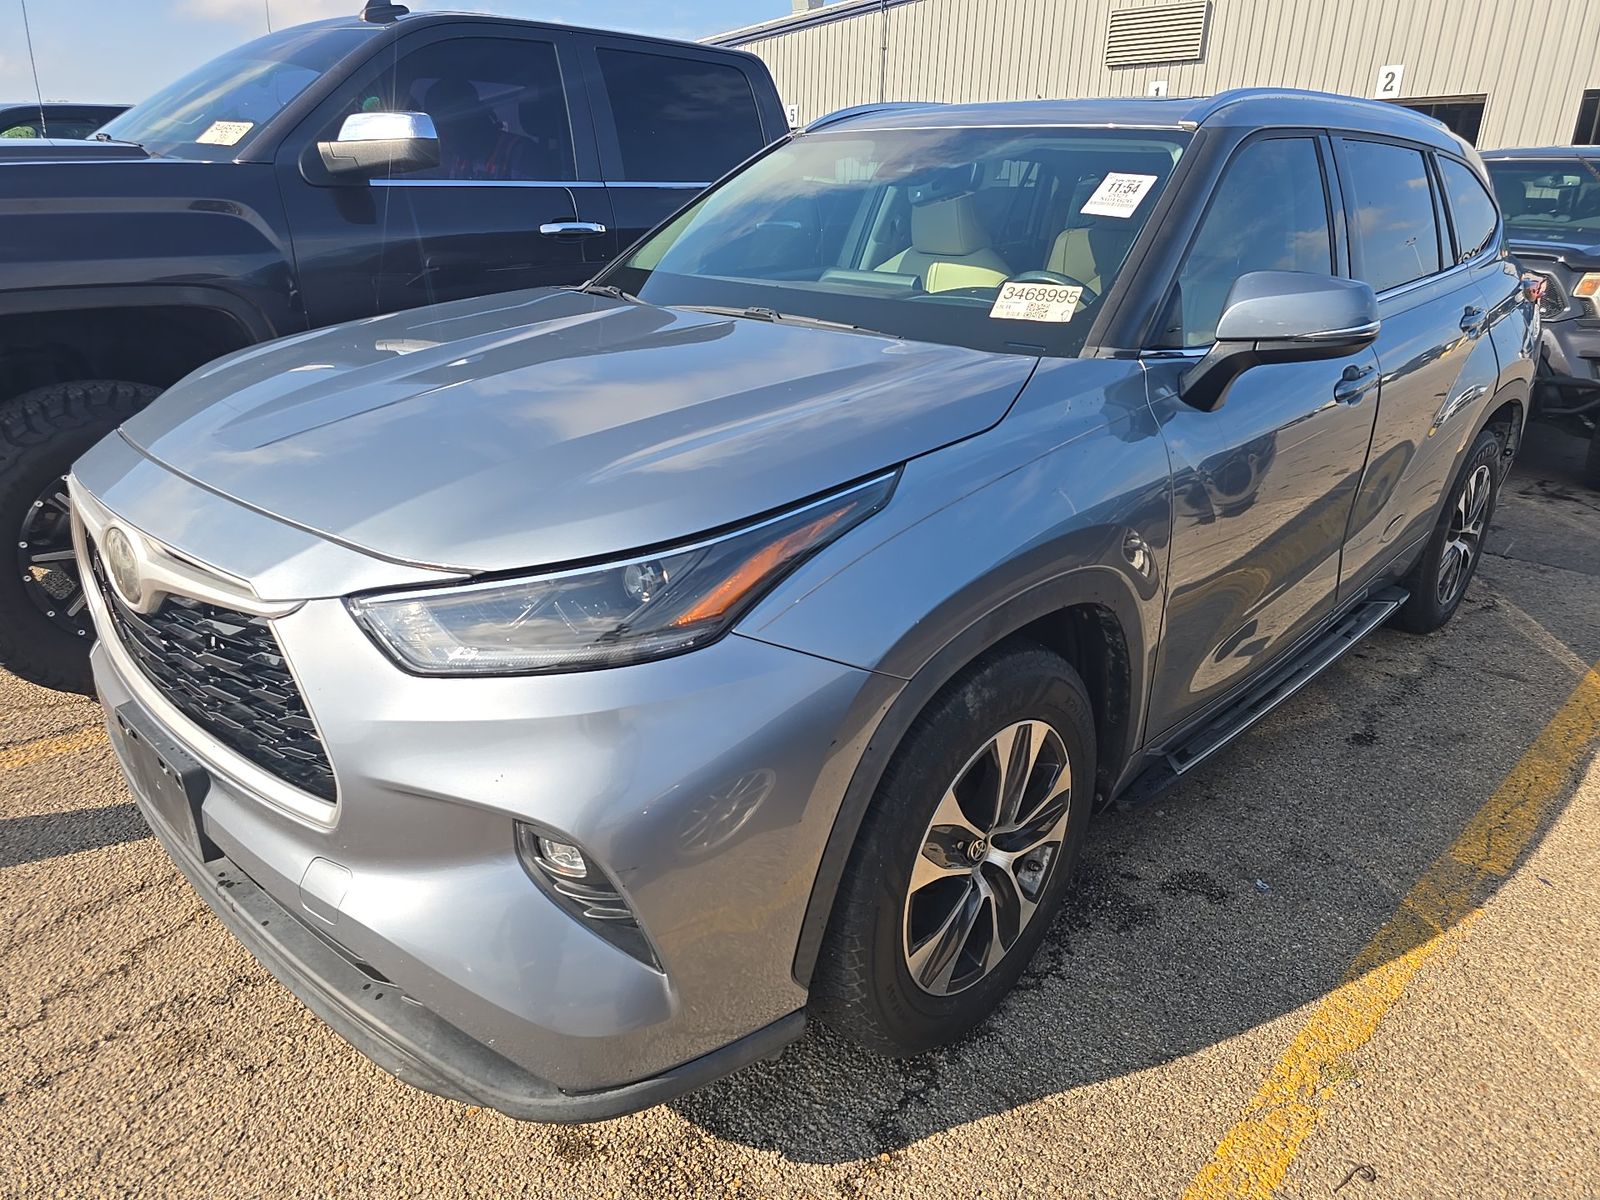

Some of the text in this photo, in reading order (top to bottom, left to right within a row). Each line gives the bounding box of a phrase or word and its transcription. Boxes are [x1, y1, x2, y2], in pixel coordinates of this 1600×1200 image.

[1382, 71, 1396, 92] 2
[1155, 86, 1160, 96] 1
[790, 108, 795, 123] 5
[1108, 182, 1141, 194] 11:54
[1003, 287, 1080, 304] 3468995
